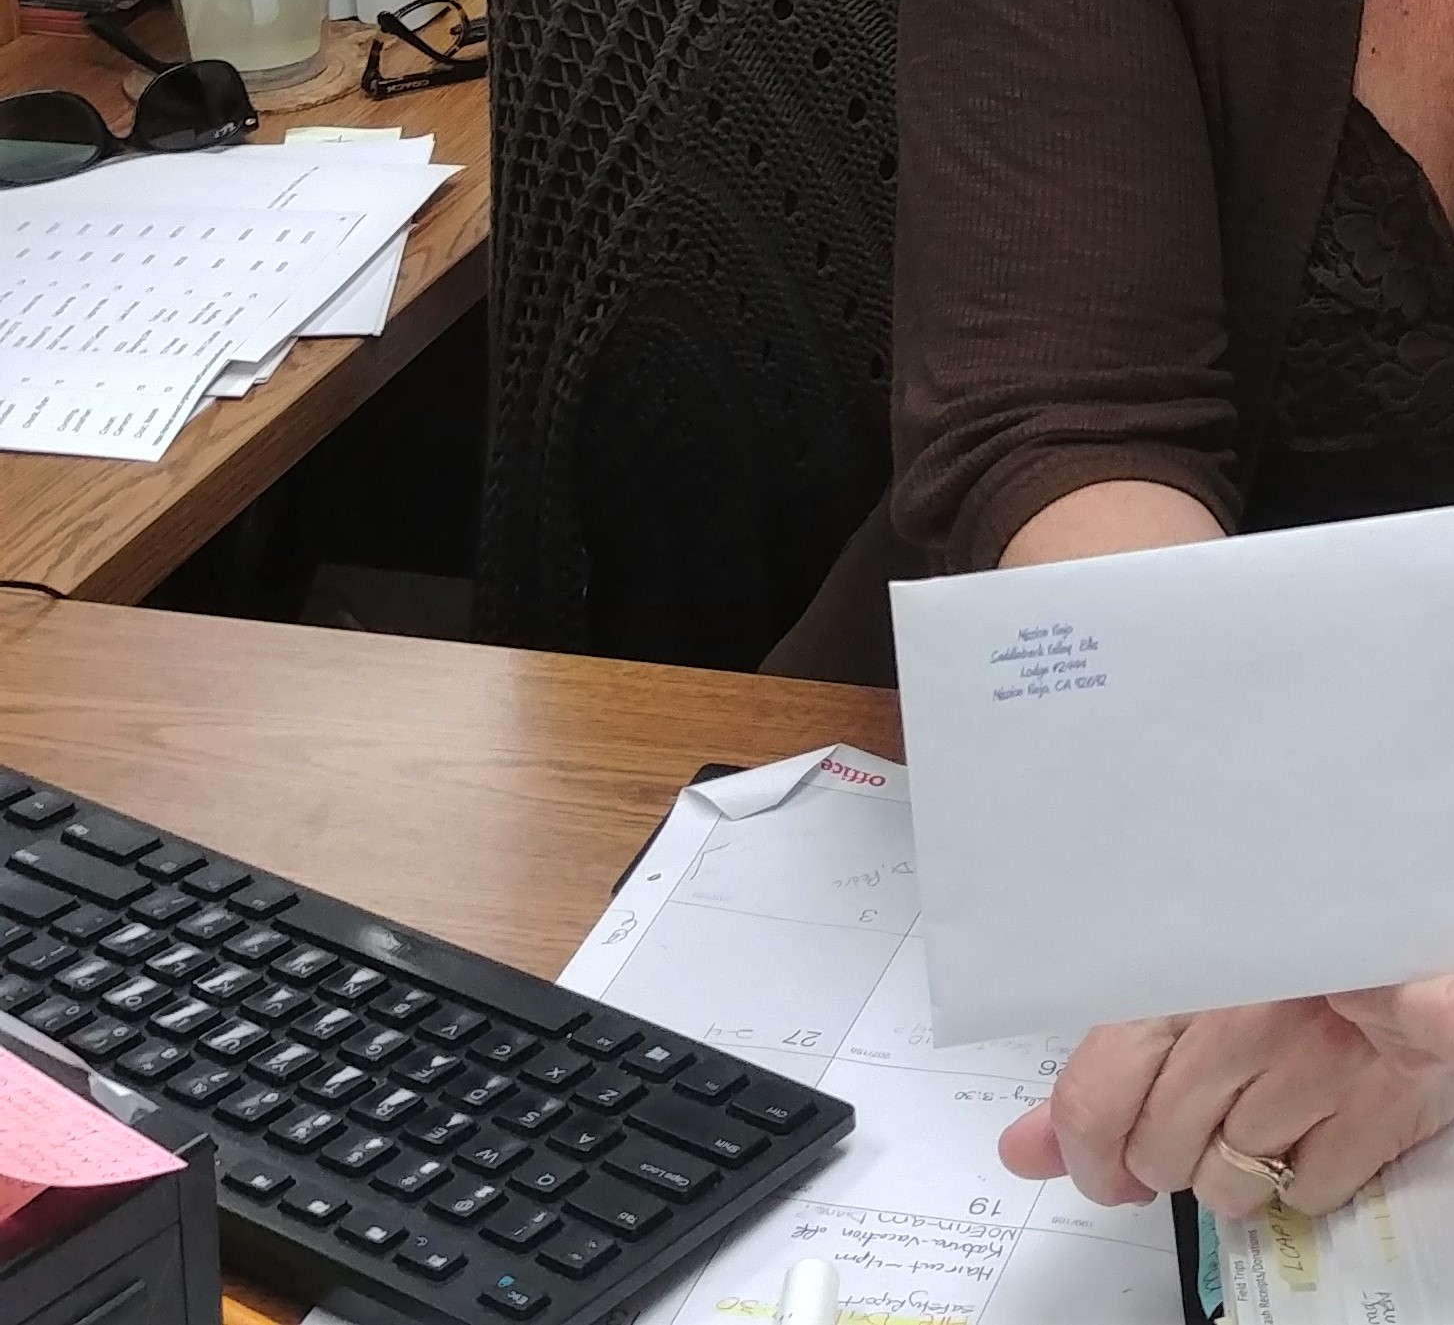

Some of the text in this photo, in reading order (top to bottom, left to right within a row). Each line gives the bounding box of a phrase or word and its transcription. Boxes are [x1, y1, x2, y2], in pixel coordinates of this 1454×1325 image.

[1055, 679, 1072, 692] CA
[858, 908, 878, 923] 3
[781, 1028, 823, 1048] 27
[597, 1088, 621, 1103] Z
[577, 1132, 597, 1144] A
[713, 1137, 742, 1154] Shift
[968, 1197, 1002, 1217] 19
